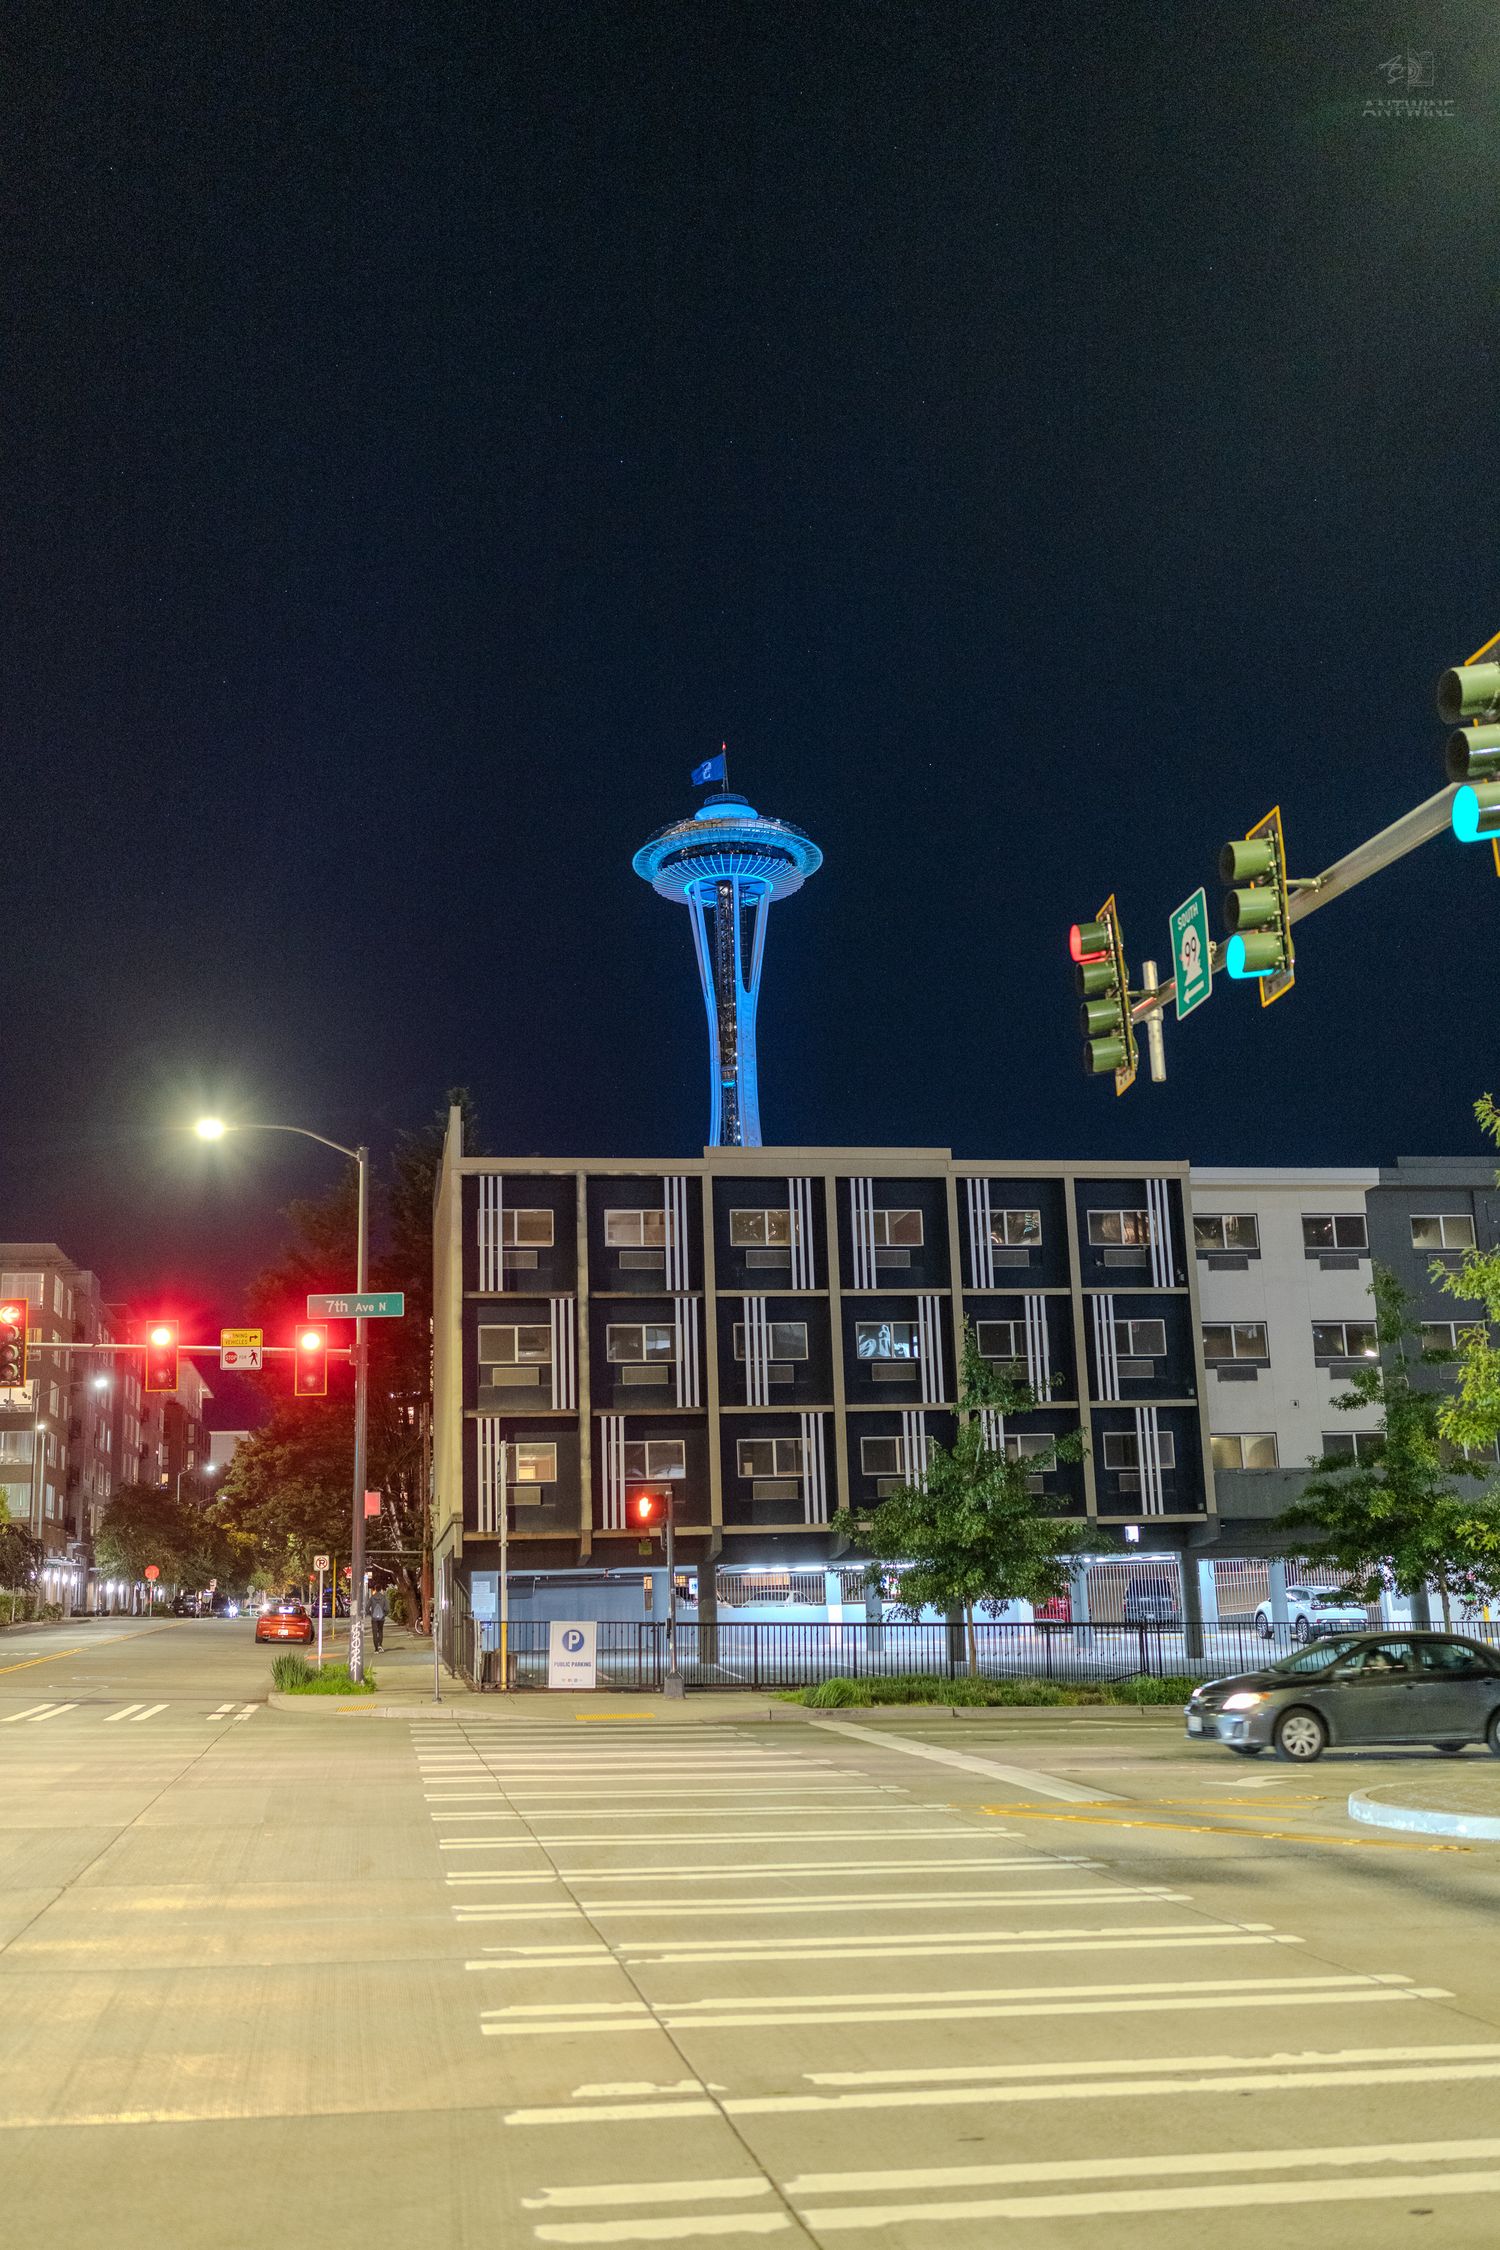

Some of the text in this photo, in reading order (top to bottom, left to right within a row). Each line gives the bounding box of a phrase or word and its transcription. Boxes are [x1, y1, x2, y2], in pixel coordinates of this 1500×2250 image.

[1177, 902, 1198, 930] SOUTH
[1185, 937, 1196, 966] 99
[326, 1300, 387, 1313] 7th Ave N
[568, 1631, 580, 1650] P
